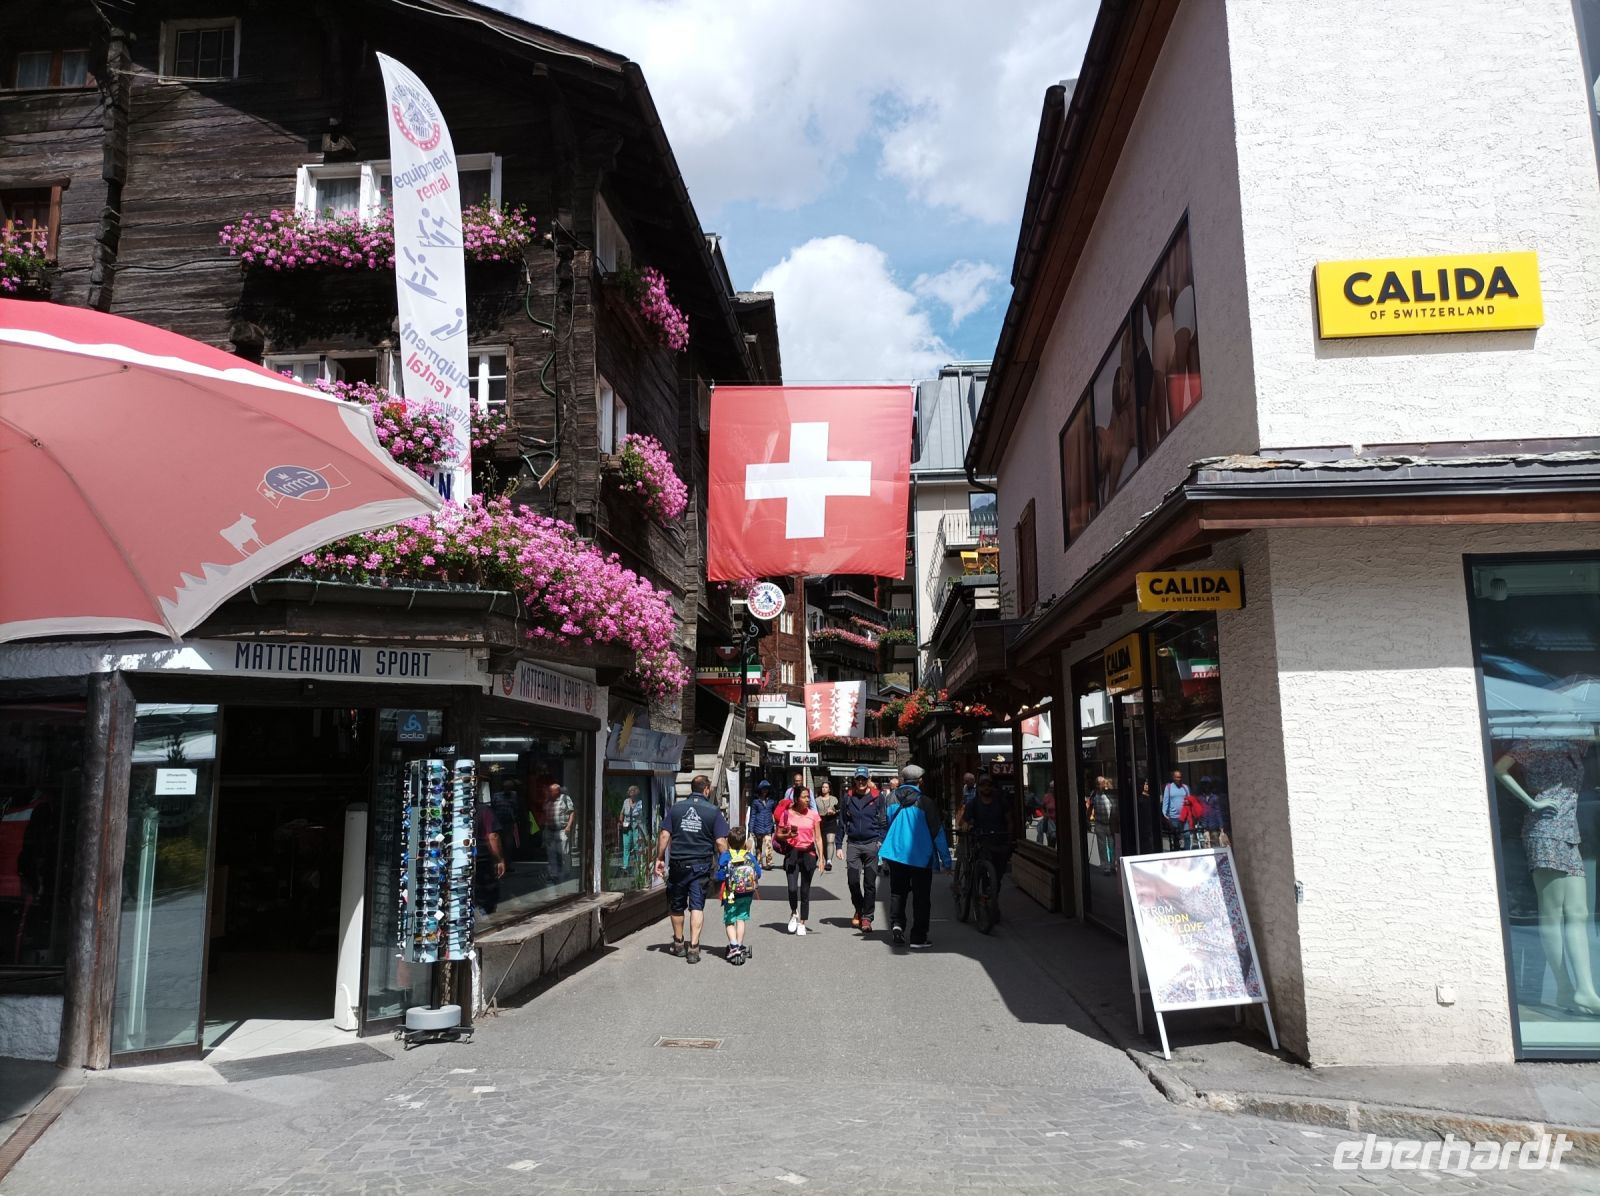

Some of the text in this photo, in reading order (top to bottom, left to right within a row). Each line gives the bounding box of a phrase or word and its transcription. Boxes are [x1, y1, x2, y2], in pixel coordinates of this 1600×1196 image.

[1343, 265, 1519, 305] CALIDA
[1370, 305, 1496, 320] OF SWITZERLAND
[1149, 576, 1232, 595] CALIDA
[1172, 595, 1220, 603] SWITZERLAND
[235, 642, 431, 677] MATTERHORN SPORT
[520, 664, 581, 709] MATTERHORN SPORT
[400, 731, 425, 739] odlo
[1152, 913, 1190, 928] ONDON
